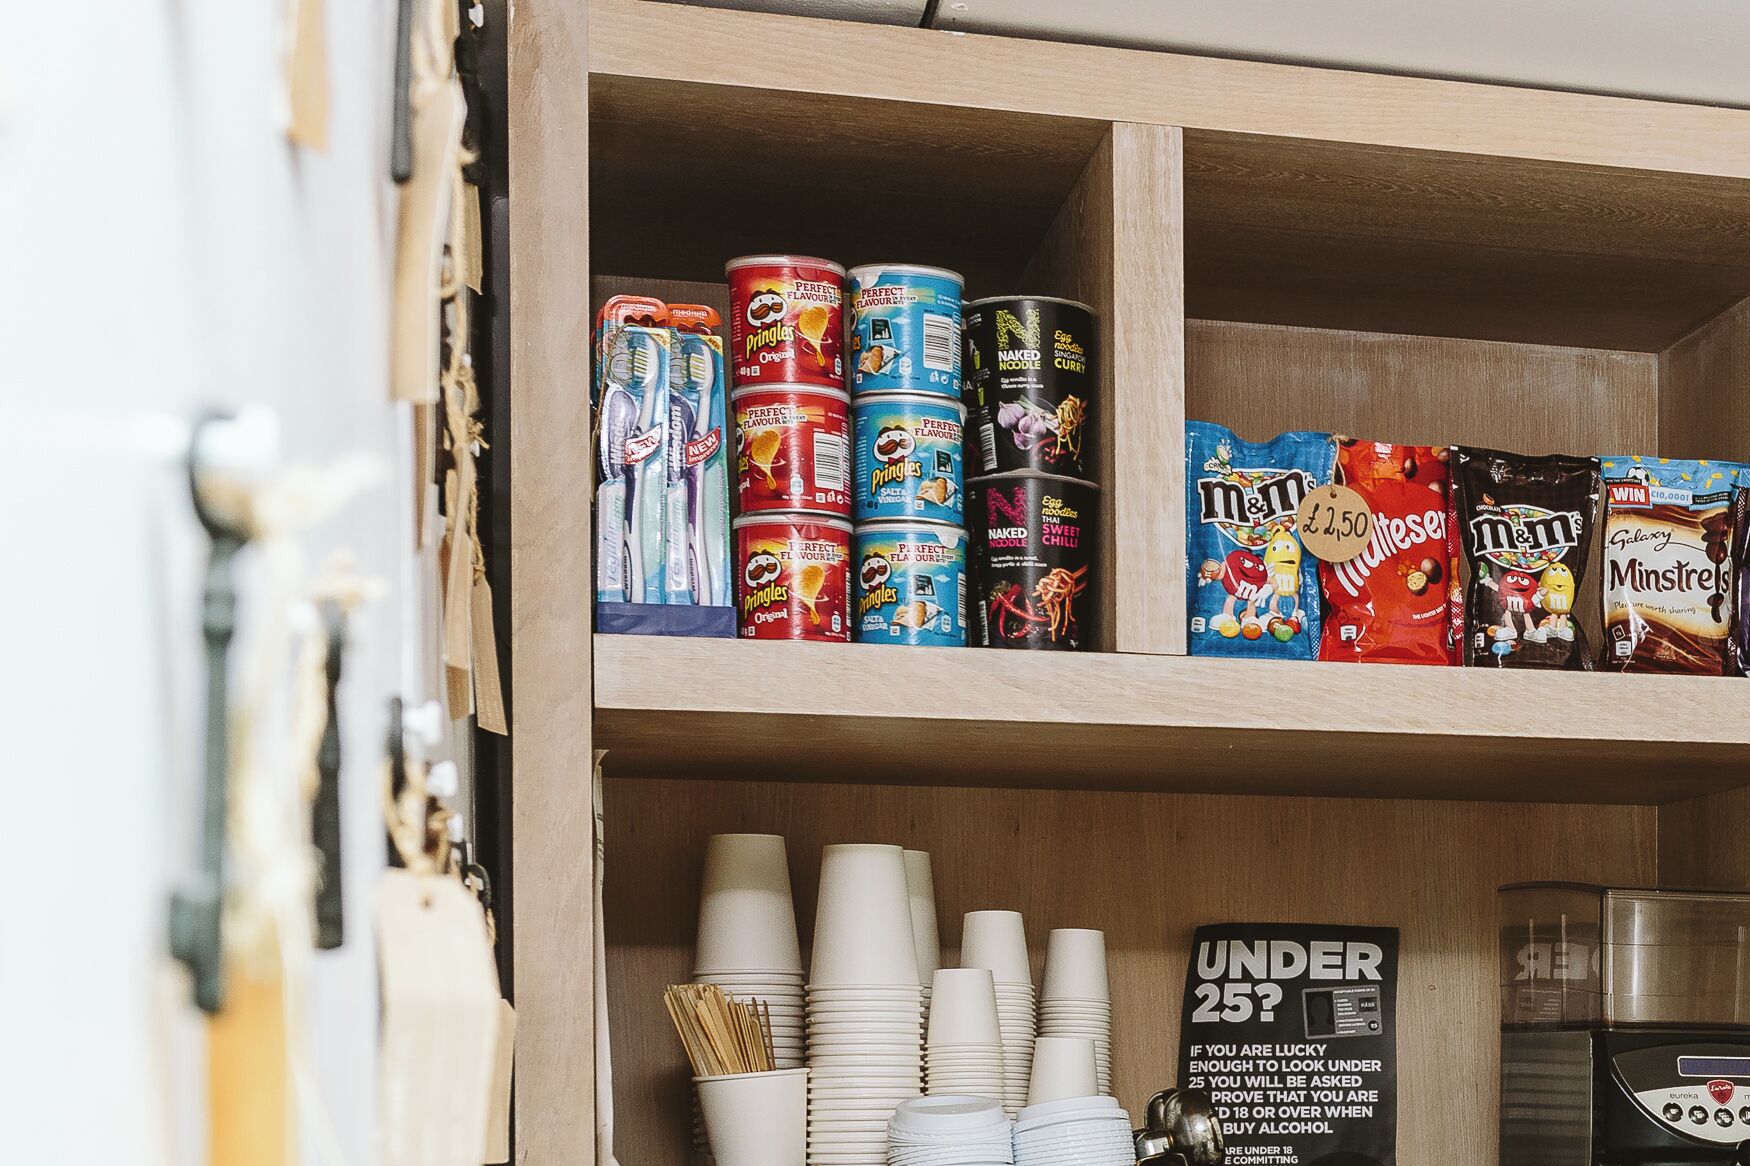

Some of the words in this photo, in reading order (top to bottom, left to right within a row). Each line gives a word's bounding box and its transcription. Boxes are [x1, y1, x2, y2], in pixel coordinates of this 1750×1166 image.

[795, 281, 837, 295] PERFECT
[861, 287, 905, 299] PERFECT
[787, 292, 829, 303] FLAVOUR
[856, 297, 893, 309] FLAVOUR
[672, 308, 708, 318] medium
[746, 322, 795, 359] Pringles
[1054, 330, 1072, 344] Egg
[1054, 341, 1084, 354] noodles
[759, 348, 796, 364] Original
[998, 349, 1042, 361] NAKED
[1054, 349, 1086, 364] SINGAPORE
[999, 360, 1042, 371] NOODLE
[1054, 358, 1086, 375] CURRY
[743, 417, 781, 430] FLAVOUR
[922, 418, 961, 434] PERFECT
[914, 428, 954, 440] FLAVOUR
[688, 432, 717, 456] NEW
[871, 458, 922, 495] Pringles
[1041, 495, 1063, 508] Egg
[1612, 486, 1647, 504] WIN
[1041, 507, 1078, 519] noodles
[1041, 516, 1060, 524] THAI
[988, 528, 1028, 539] NAKED
[1041, 524, 1081, 537] SWEET
[988, 539, 1028, 548] NOODLE
[1041, 535, 1078, 548] CHILLI
[1609, 528, 1674, 552] Galaxy
[1609, 558, 1730, 593] Minstrels
[744, 582, 788, 620] Pringles
[754, 608, 789, 624] Original
[1645, 602, 1667, 613] worth
[1668, 605, 1697, 617] sharing
[1197, 940, 1383, 981] UNDER
[1192, 982, 1283, 1023] 25?
[1190, 1045, 1203, 1057] IF
[1206, 1044, 1236, 1057] YOU
[1240, 1044, 1273, 1057] ARE
[1275, 1044, 1327, 1057] LUCKY
[1189, 1060, 1253, 1073] ENOUGH
[1256, 1060, 1279, 1072] TO
[1282, 1060, 1325, 1072] LOOK
[1328, 1060, 1382, 1072] UNDER
[1188, 1076, 1205, 1089] 25
[1208, 1076, 1241, 1088] YOU
[1244, 1076, 1284, 1088] WILL
[1286, 1076, 1307, 1088] BE
[1310, 1076, 1363, 1088] ASKED
[1211, 1091, 1264, 1104] PROVE
[1266, 1091, 1307, 1103] THAT
[1310, 1091, 1344, 1103] YOU
[1346, 1090, 1379, 1103] ARE
[1669, 1092, 1699, 1100] eureka
[1233, 1106, 1249, 1119] 18
[1252, 1106, 1275, 1119] OR
[1278, 1106, 1321, 1118] OVER
[1324, 1106, 1373, 1118] WHEN
[1223, 1122, 1256, 1135] BUY
[1258, 1122, 1334, 1134] ALCOHOL
[1244, 1146, 1281, 1155] UNDER
[1282, 1146, 1293, 1155] 18
[1233, 1156, 1299, 1165] COMMITTING
